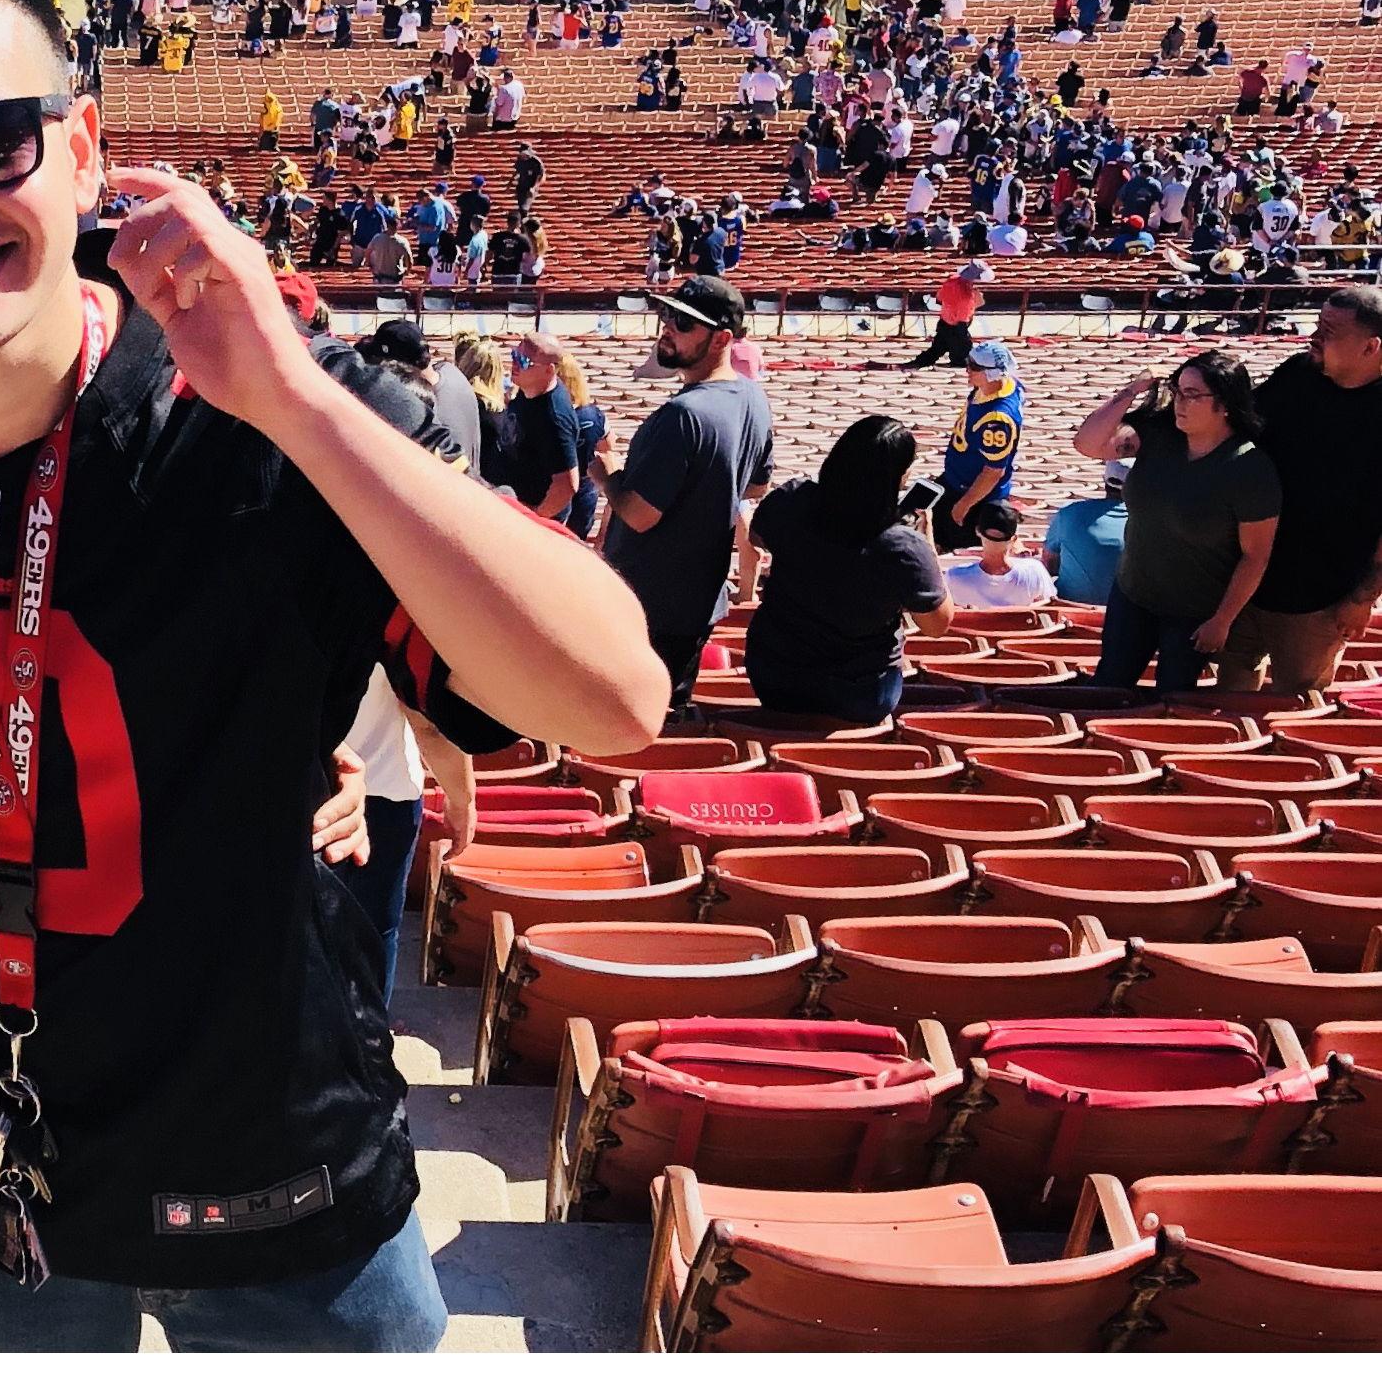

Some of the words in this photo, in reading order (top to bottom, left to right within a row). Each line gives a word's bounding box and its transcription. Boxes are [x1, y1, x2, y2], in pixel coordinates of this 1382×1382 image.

[1271, 215, 1290, 233] 30
[982, 429, 1007, 448] 99
[16, 495, 54, 637] 49ERS
[689, 802, 774, 818] CRUISES
